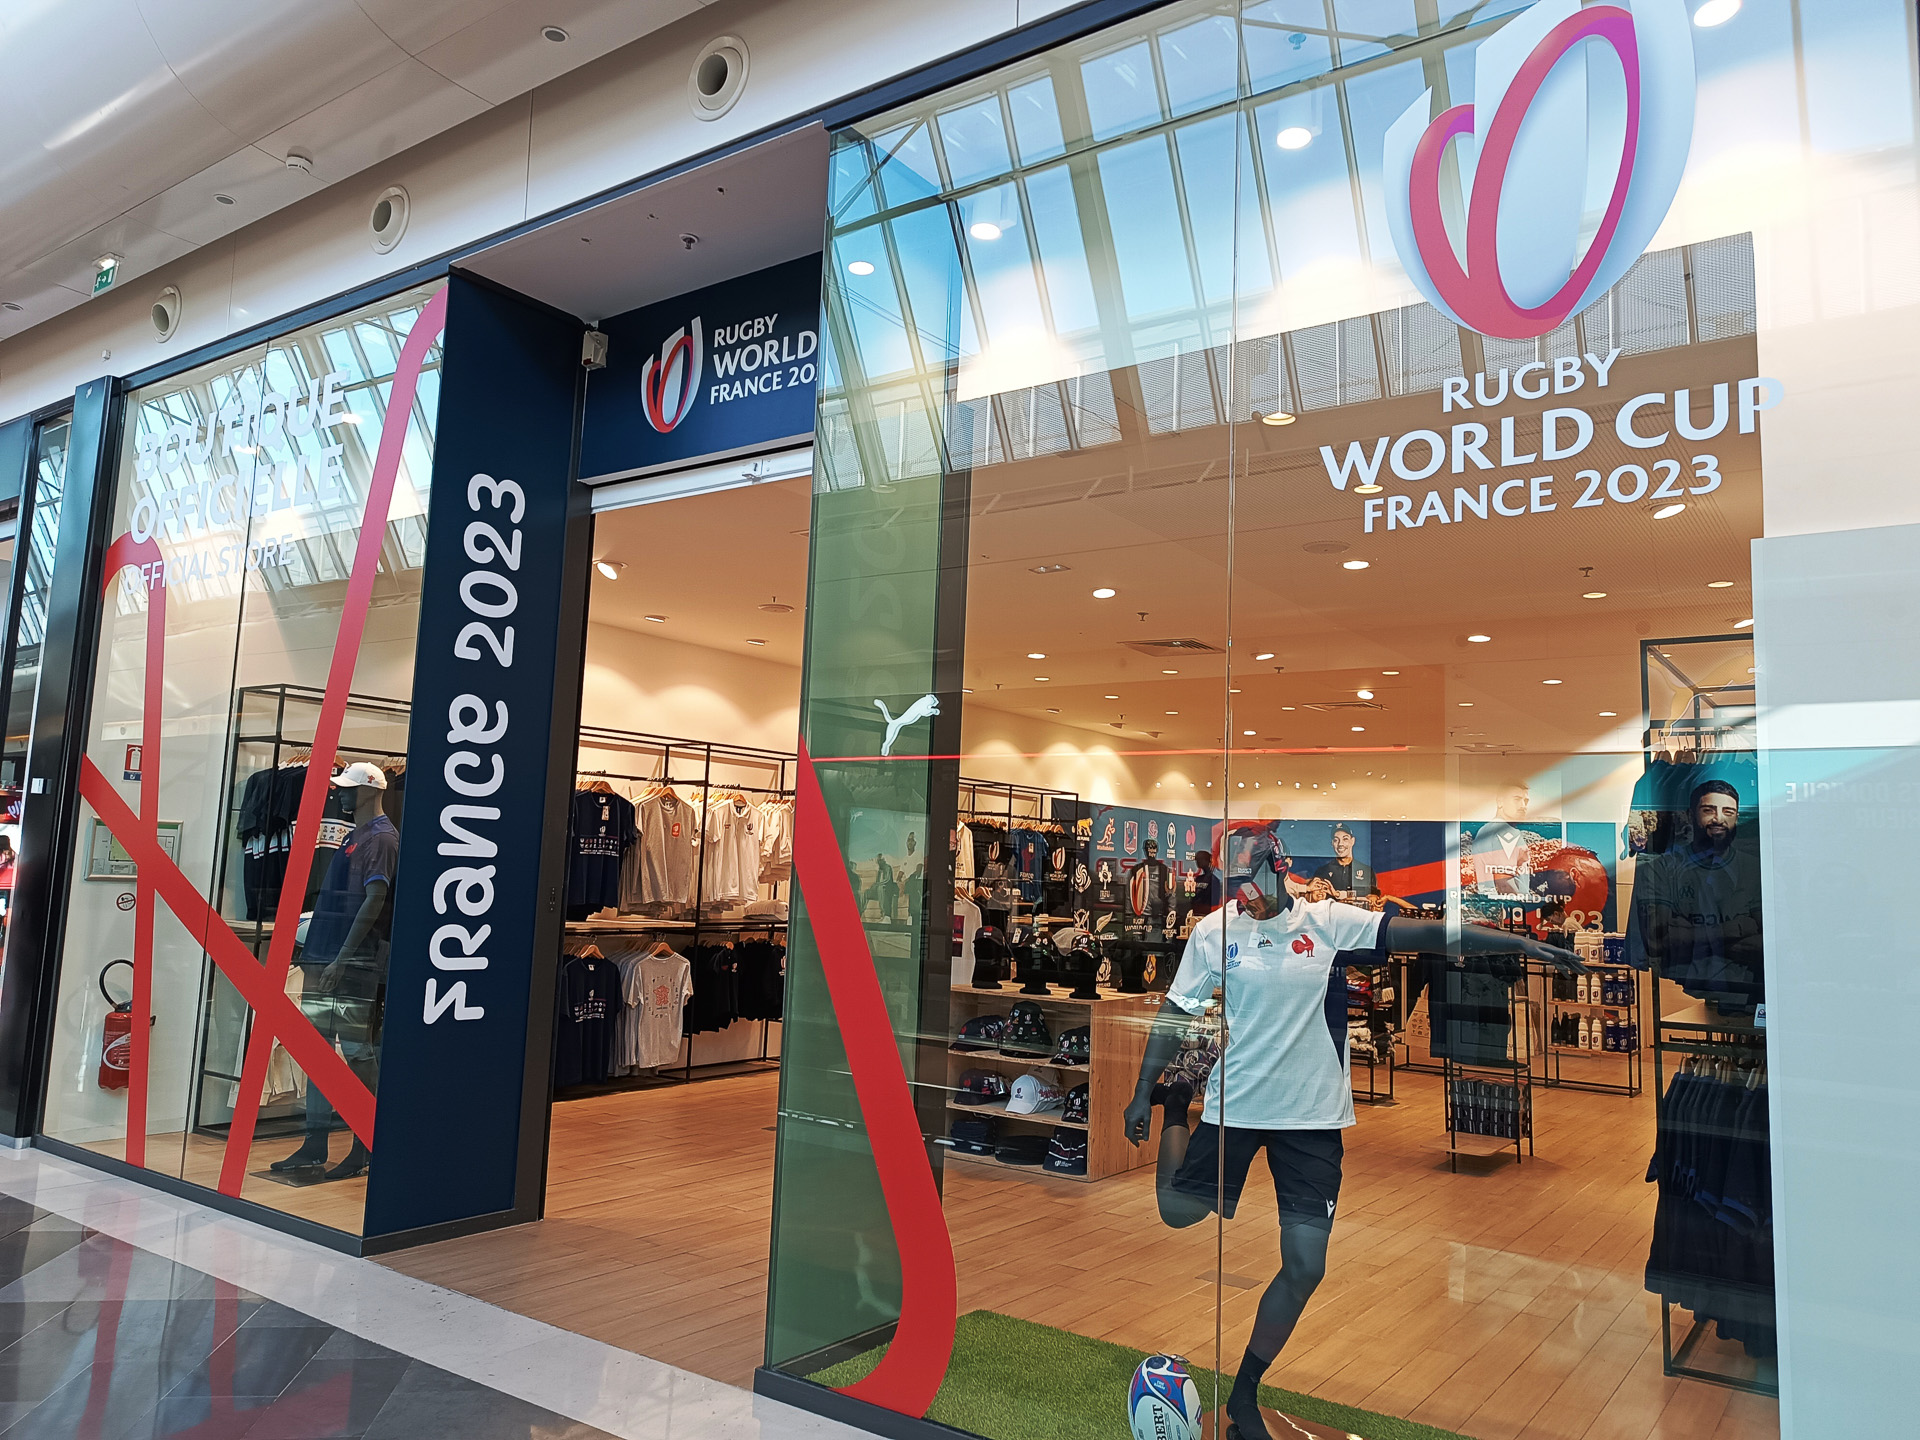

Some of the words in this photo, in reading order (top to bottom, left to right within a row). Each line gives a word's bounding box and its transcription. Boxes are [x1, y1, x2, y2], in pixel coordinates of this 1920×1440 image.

[713, 314, 778, 348] RUGBY
[713, 331, 817, 378] WORLD
[710, 371, 782, 405] FRANCE
[788, 362, 818, 387] 20
[1443, 348, 1622, 413] RUGBY
[135, 370, 351, 482] BOUTIQUE
[1318, 407, 1594, 491] WORLD
[1615, 377, 1784, 449] CUP
[130, 443, 344, 544] OFFICIELLE
[1364, 476, 1557, 533] FRANCE
[1572, 454, 1723, 509] 2023
[123, 552, 213, 596] OFFICIAL
[217, 533, 295, 577] STORE
[454, 474, 526, 668] 2023
